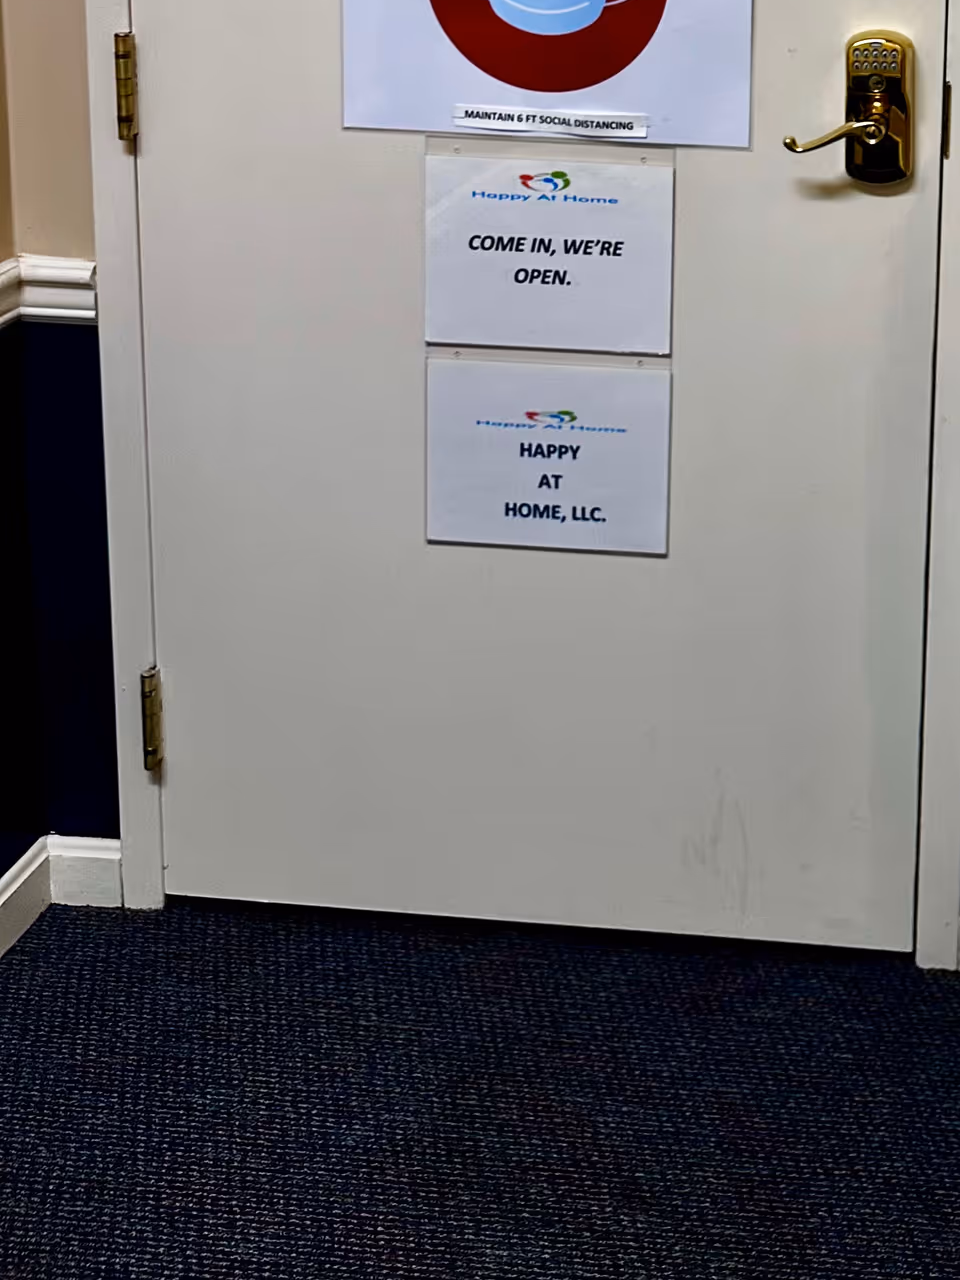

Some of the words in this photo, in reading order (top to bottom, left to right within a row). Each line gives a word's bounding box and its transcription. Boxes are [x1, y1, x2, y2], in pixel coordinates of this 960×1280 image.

[464, 110, 511, 122] MAINTAIN
[517, 114, 523, 122] 6
[526, 115, 537, 123] FT
[539, 115, 572, 127] SOCIAL
[574, 119, 634, 130] DISTANCING
[472, 191, 531, 202] Happy
[564, 195, 618, 204] Home
[468, 235, 526, 252] COME
[531, 238, 556, 256] IN,
[563, 239, 624, 256] WE’RE
[514, 268, 571, 285] OPEN.
[520, 443, 580, 460] HAPPY
[538, 474, 563, 489] AT
[505, 502, 566, 522] HOME,
[572, 506, 607, 522] LLC.
